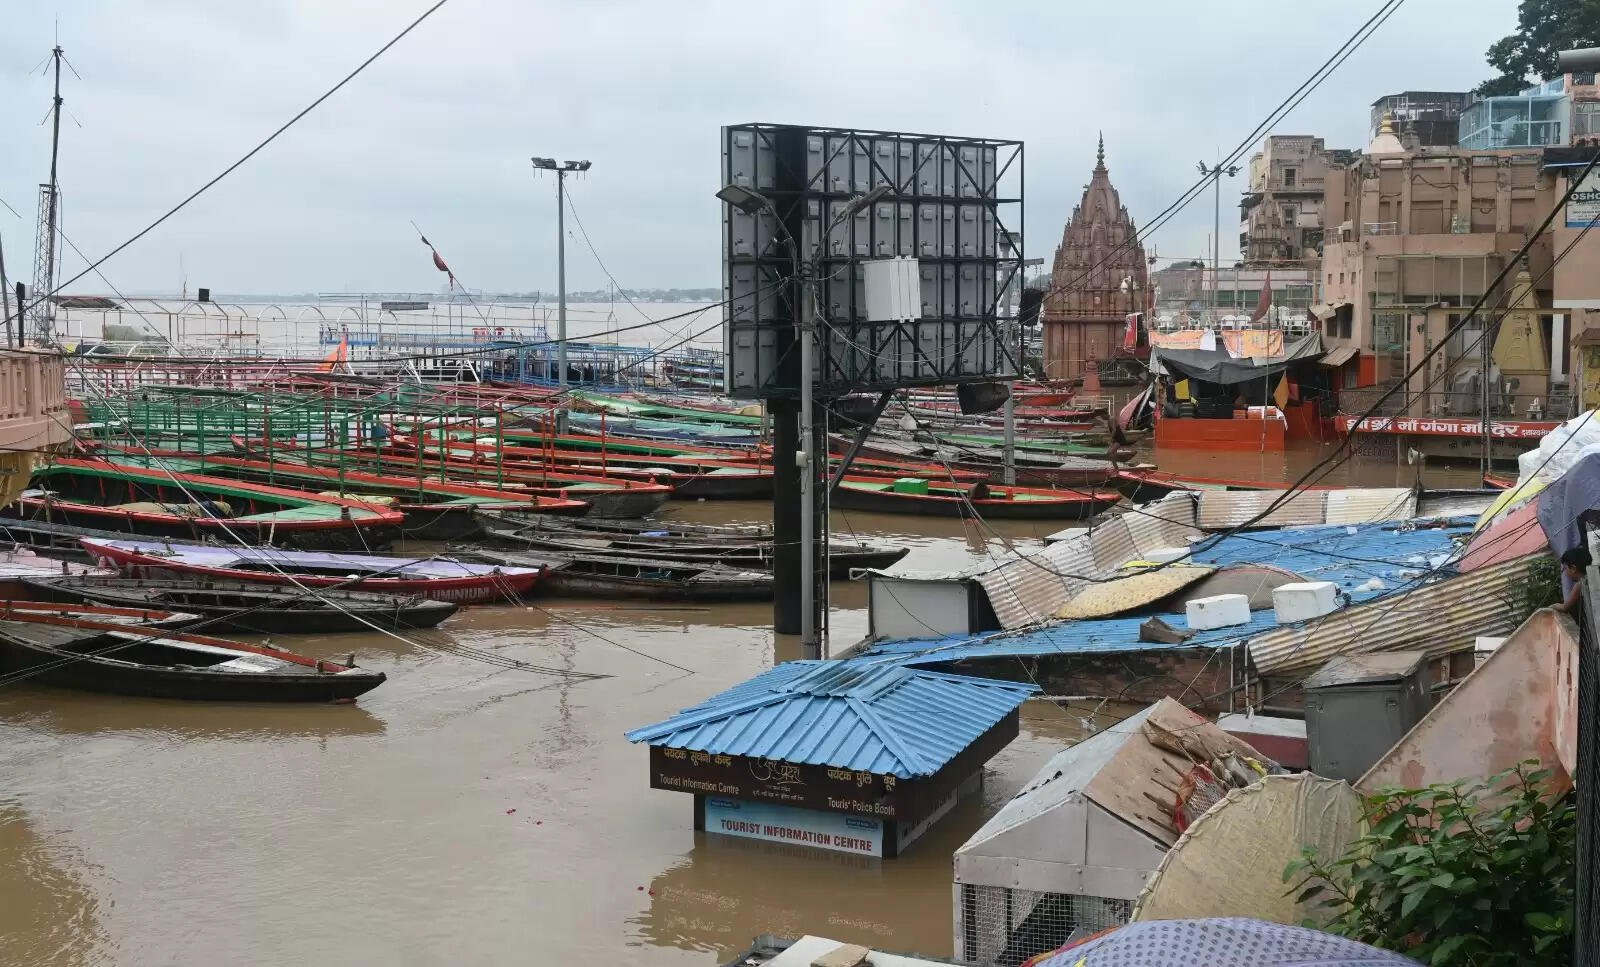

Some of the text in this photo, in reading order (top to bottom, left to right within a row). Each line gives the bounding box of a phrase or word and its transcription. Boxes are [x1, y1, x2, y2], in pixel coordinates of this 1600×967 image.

[1420, 420, 1460, 433] गंगा
[659, 773, 681, 787] Tourist
[683, 777, 717, 792] Information
[852, 800, 873, 812] Police
[874, 803, 896, 815] Booth
[720, 819, 873, 852] TOURIST INFORMATION CENTRE
